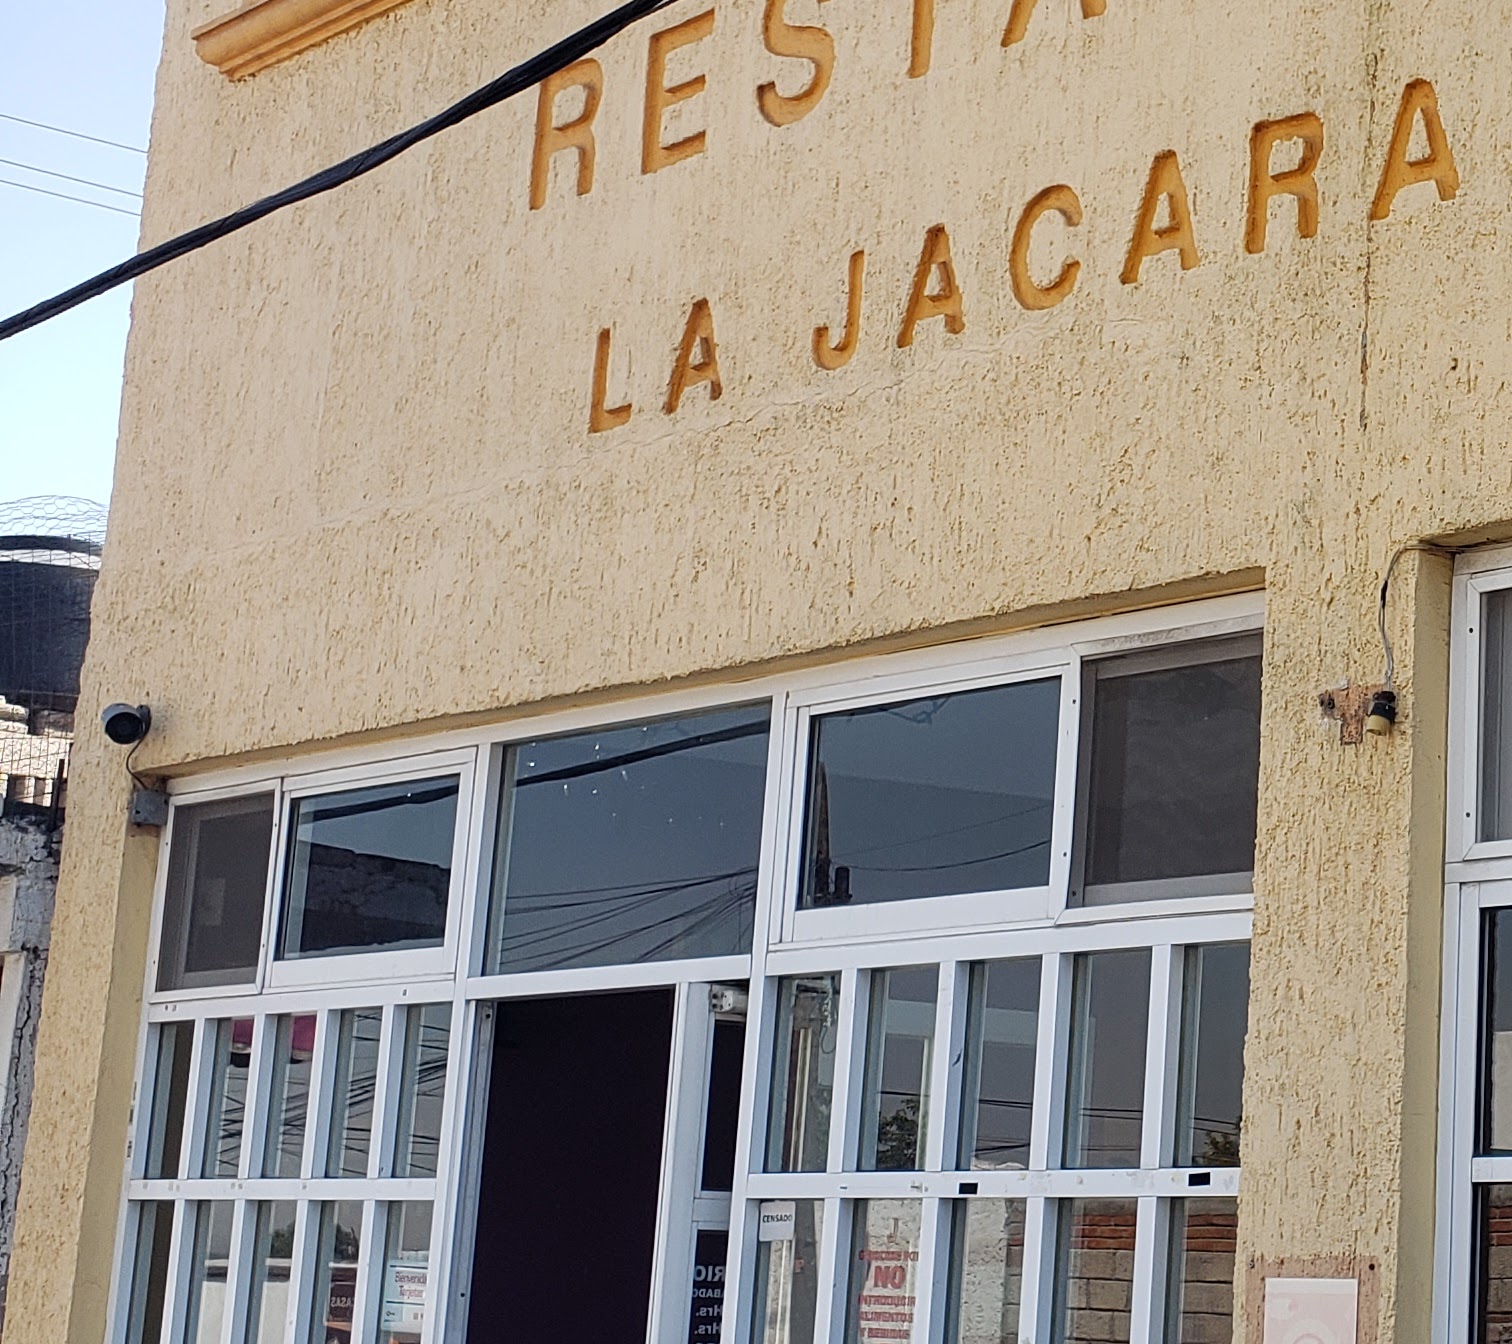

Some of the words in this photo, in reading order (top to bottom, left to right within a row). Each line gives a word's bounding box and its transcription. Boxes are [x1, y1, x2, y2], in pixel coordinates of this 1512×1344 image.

[588, 296, 722, 433] LA
[762, 1213, 792, 1224] CENSADO
[873, 1265, 906, 1290] NO
